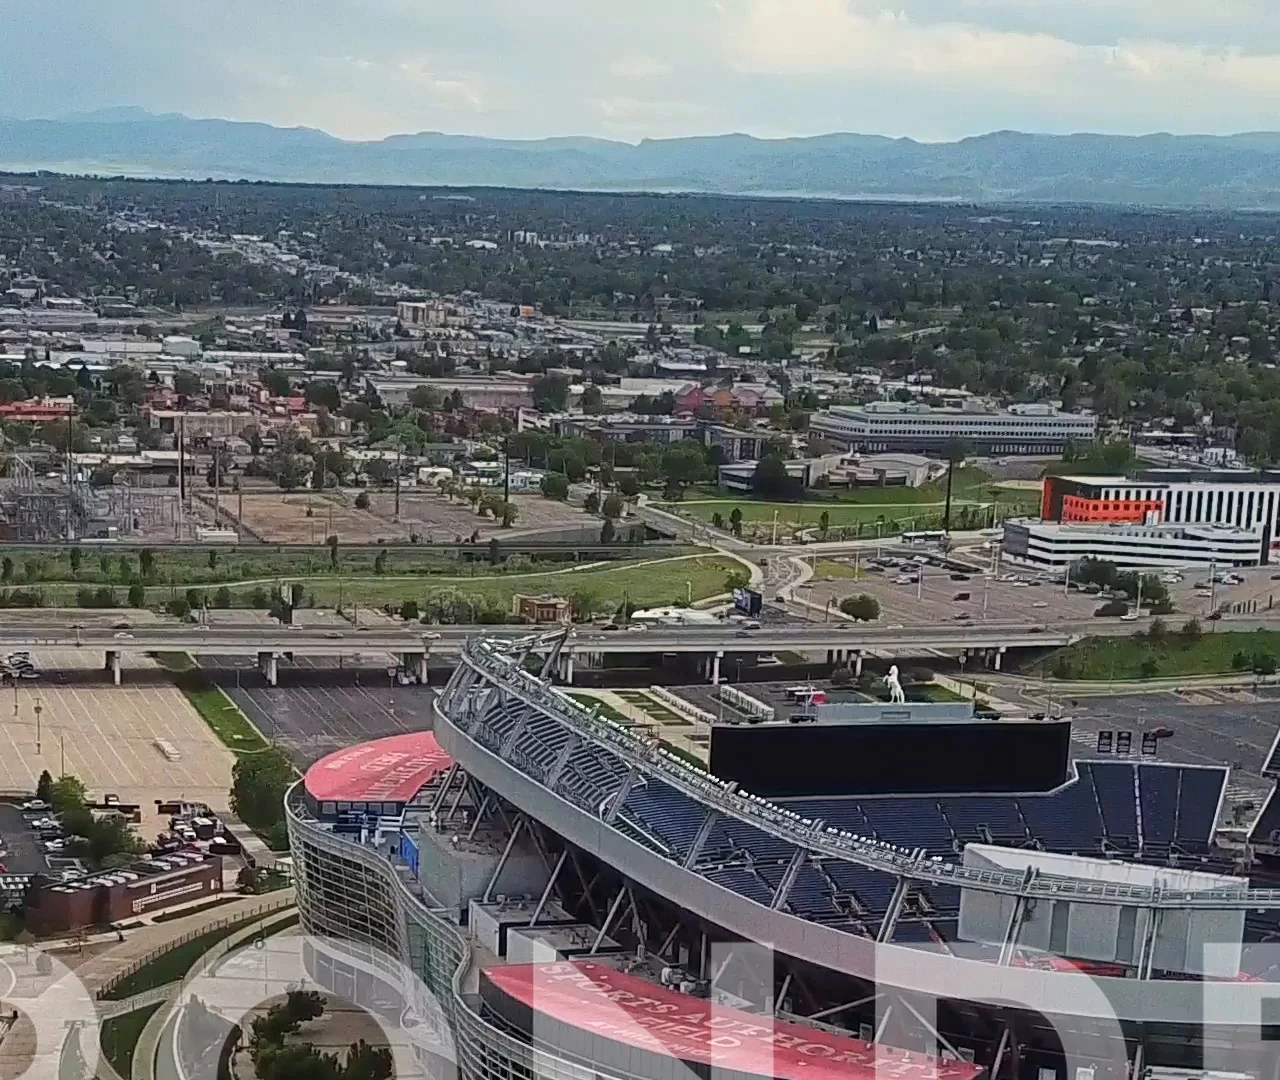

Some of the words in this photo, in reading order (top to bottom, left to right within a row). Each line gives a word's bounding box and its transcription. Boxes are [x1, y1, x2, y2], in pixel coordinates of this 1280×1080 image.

[540, 964, 679, 1014] SPORTS
[669, 1012, 961, 1080] AUTHORITY
[637, 1016, 742, 1048] FIELD
